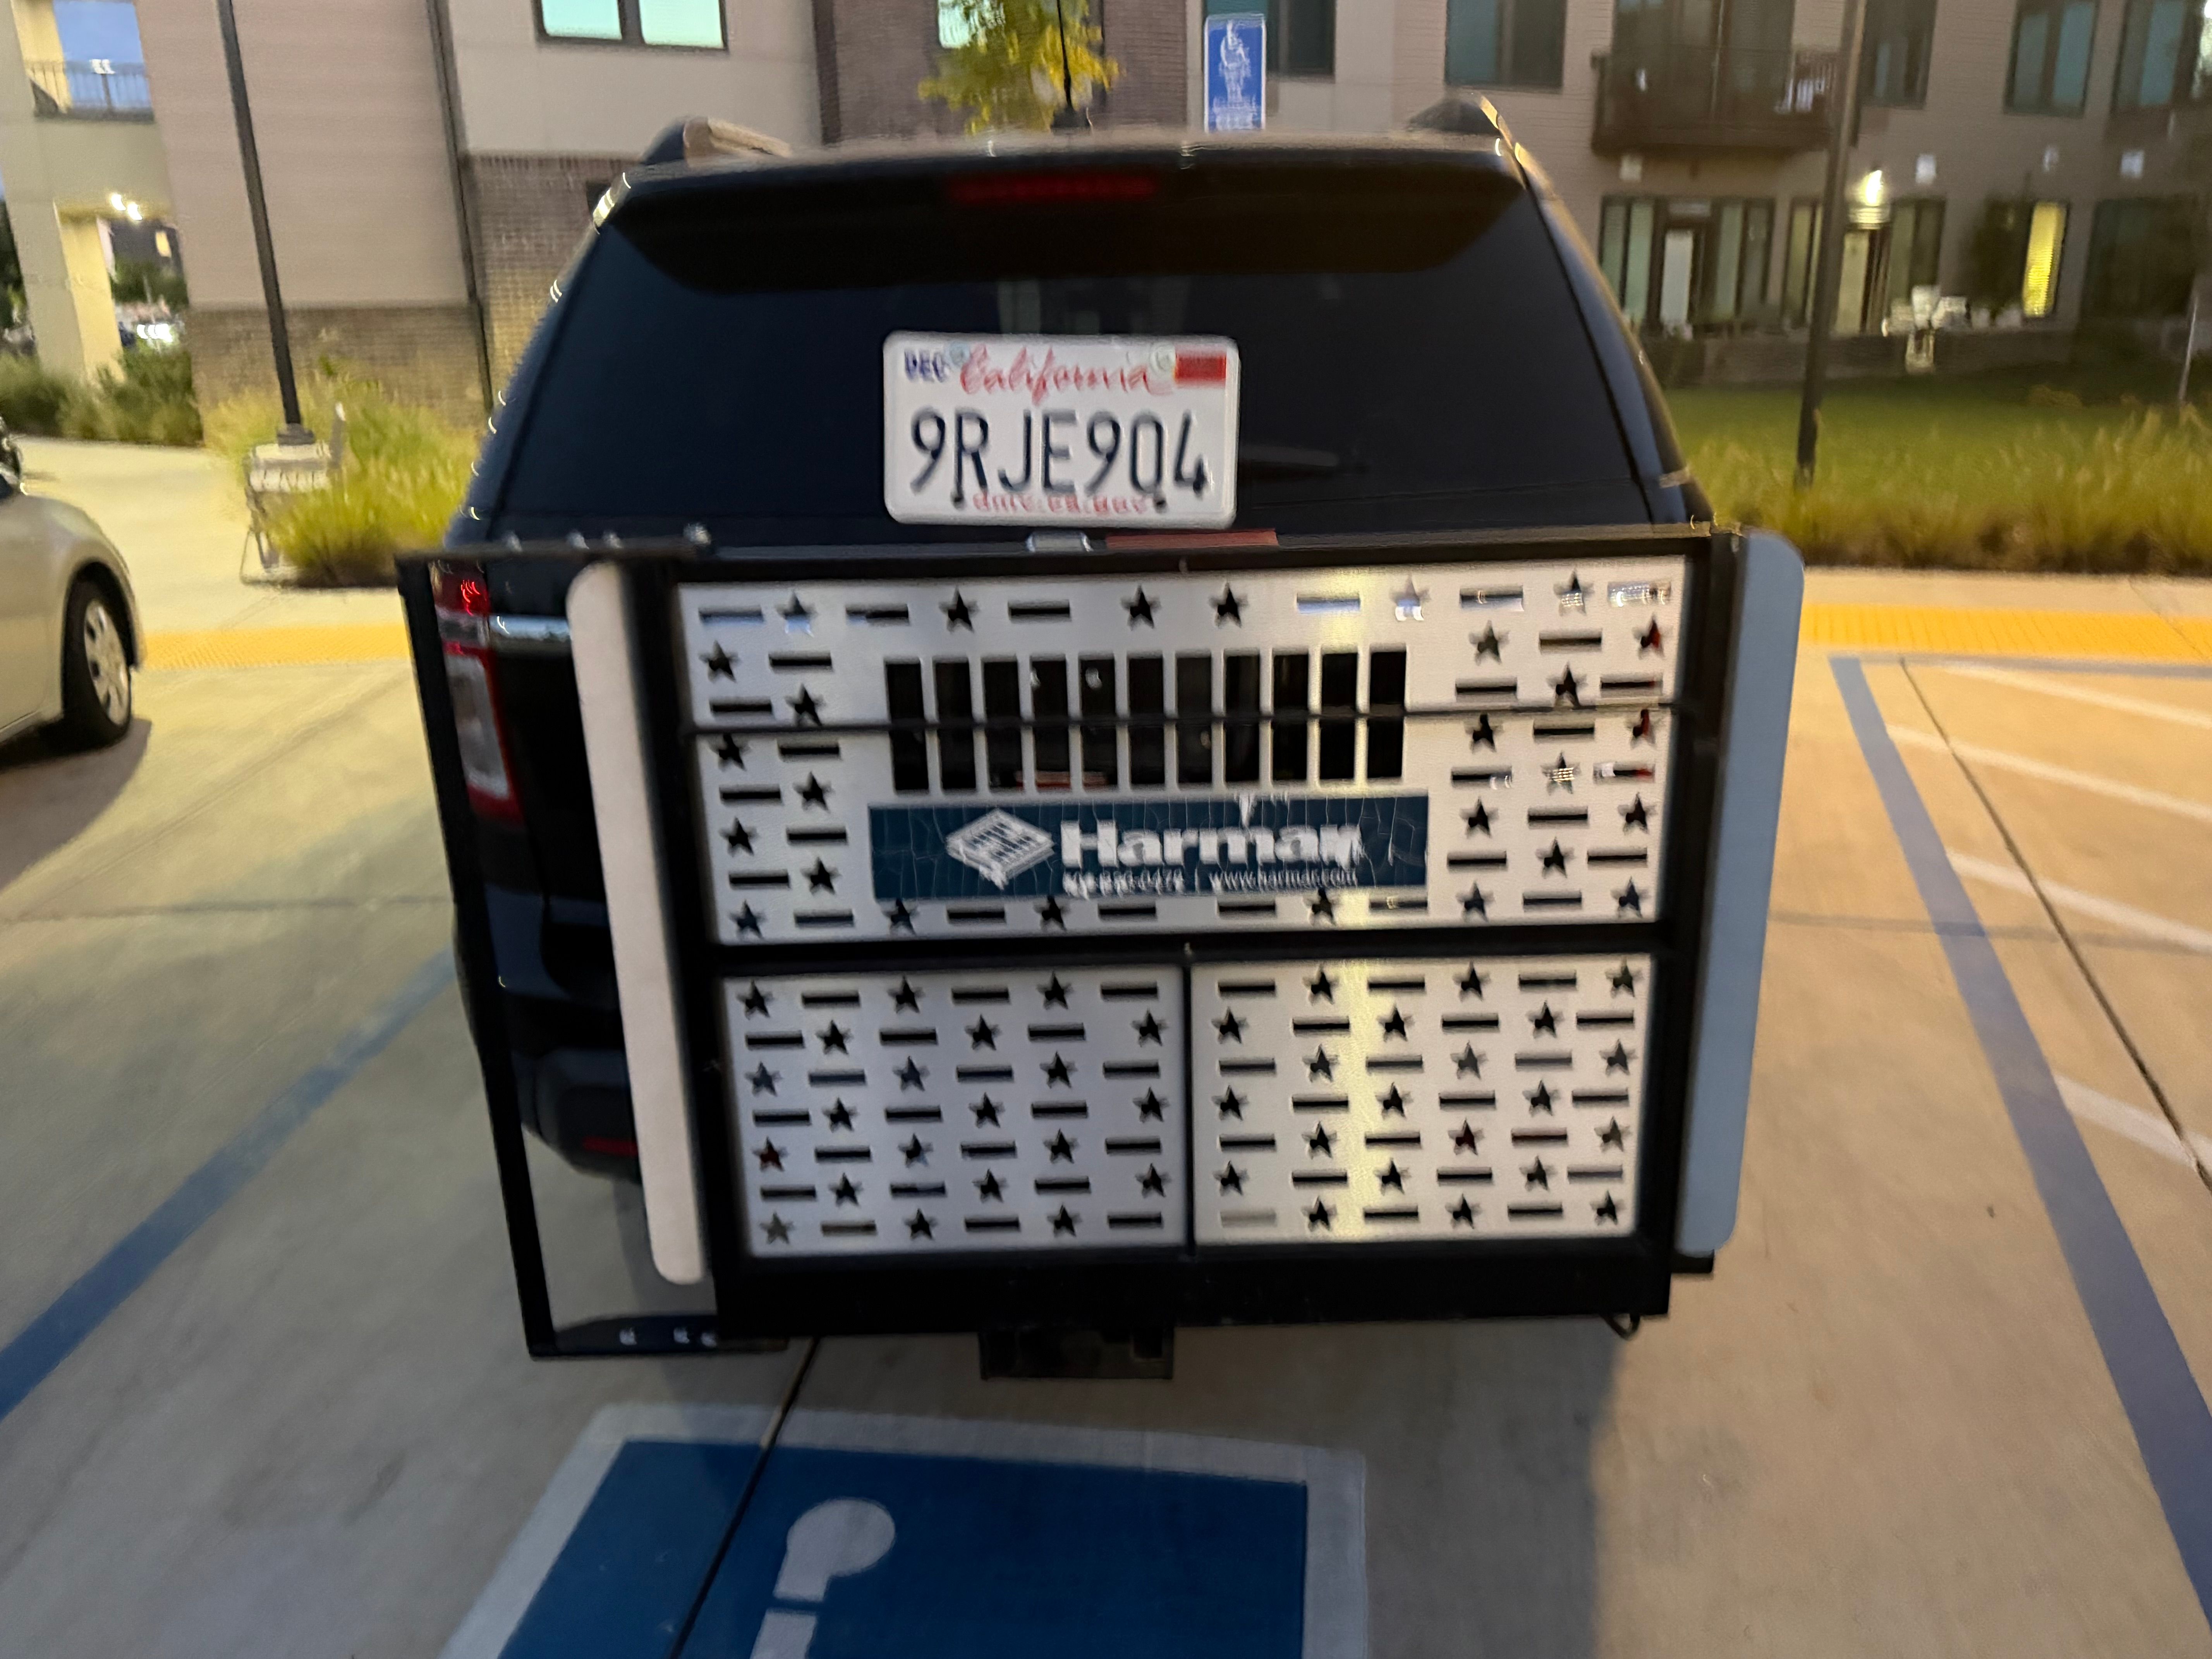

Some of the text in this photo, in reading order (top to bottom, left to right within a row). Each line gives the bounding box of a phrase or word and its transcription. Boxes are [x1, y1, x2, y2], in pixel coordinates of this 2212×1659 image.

[960, 342, 1173, 406] California
[910, 407, 1206, 500] 9RJE904
[1060, 819, 1364, 869] Harmar
